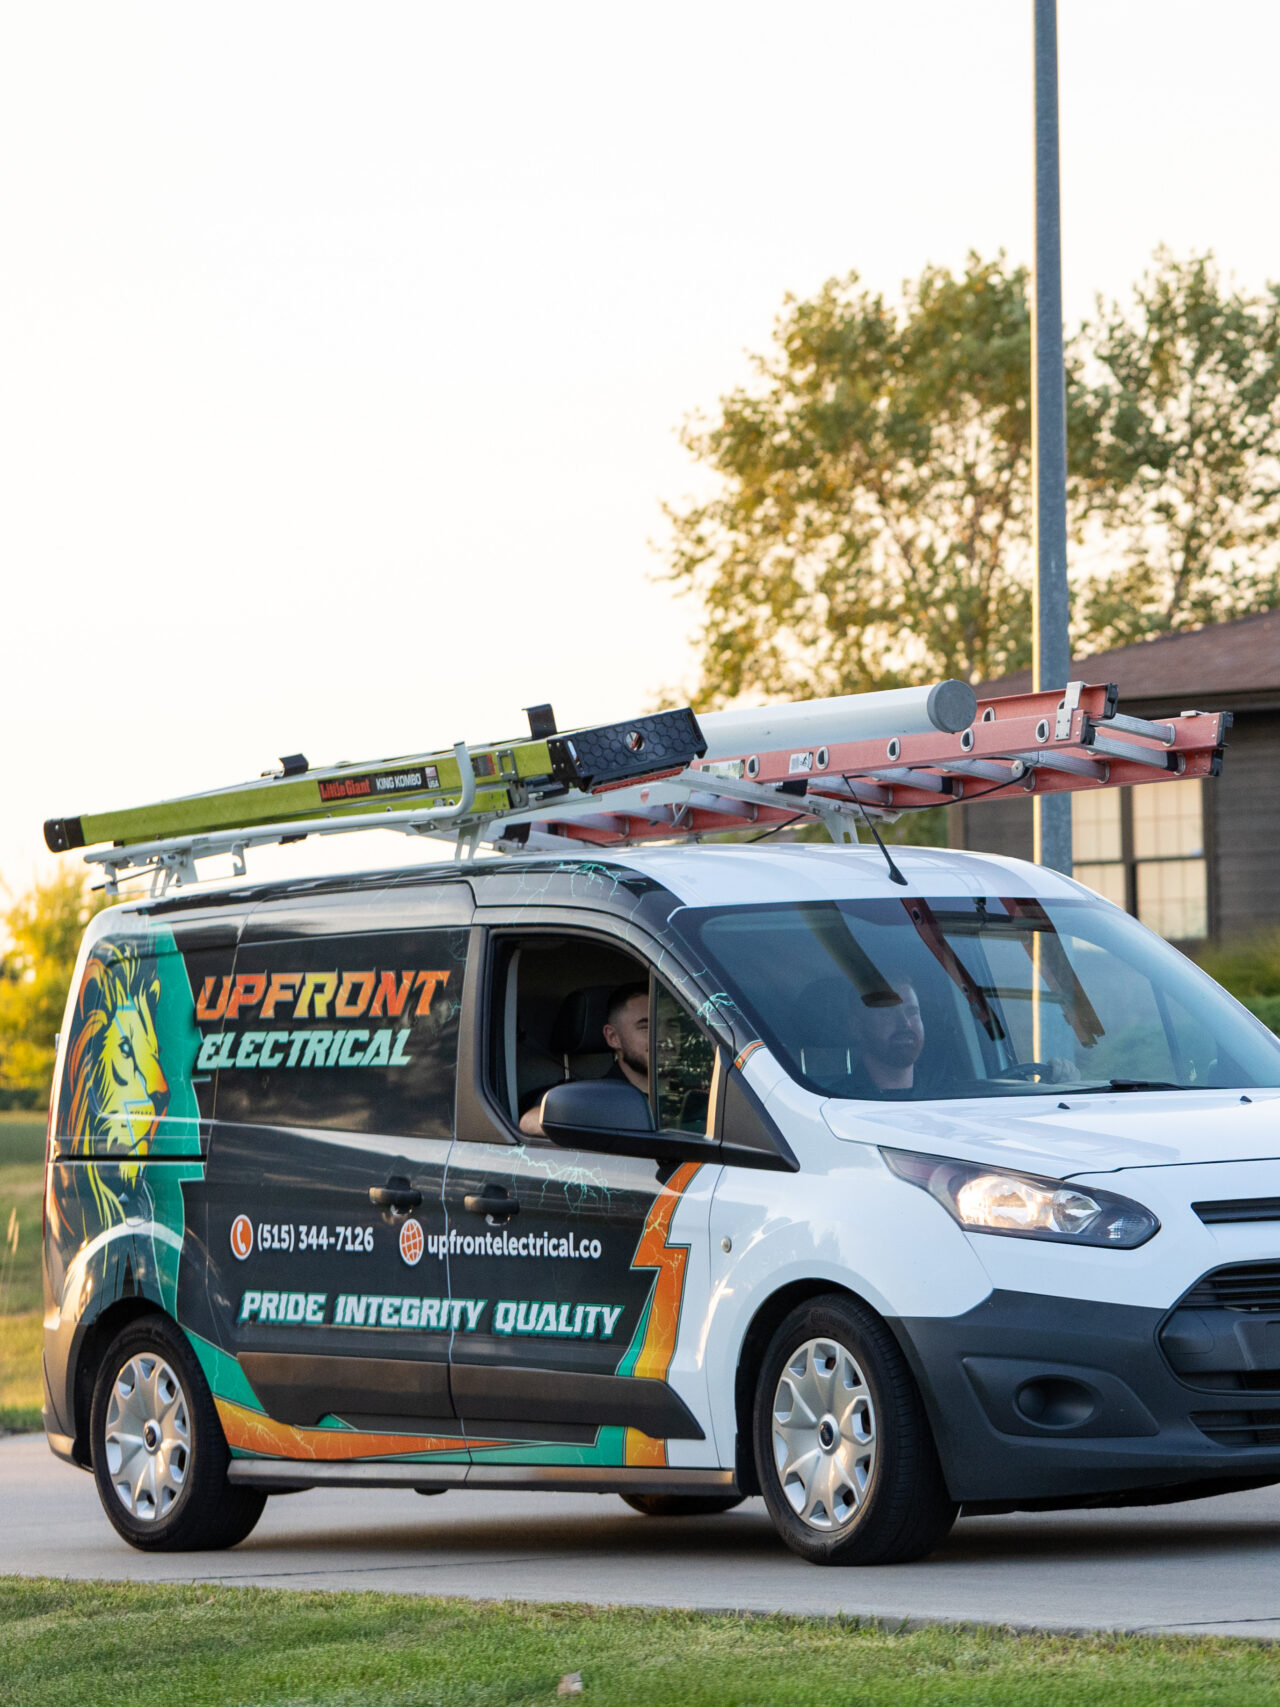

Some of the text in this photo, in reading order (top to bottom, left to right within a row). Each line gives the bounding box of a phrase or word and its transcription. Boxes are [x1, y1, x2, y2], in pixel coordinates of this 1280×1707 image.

[375, 773, 422, 791] KING KOMBO
[196, 969, 451, 1020] UPFRONT
[197, 1028, 412, 1070] ELECTRICAL
[257, 1223, 375, 1252] (515) 344-7126
[427, 1229, 602, 1259] upfrontelectrical.co
[238, 1289, 625, 1338] PRIDE INTEGRITY QUALITY
